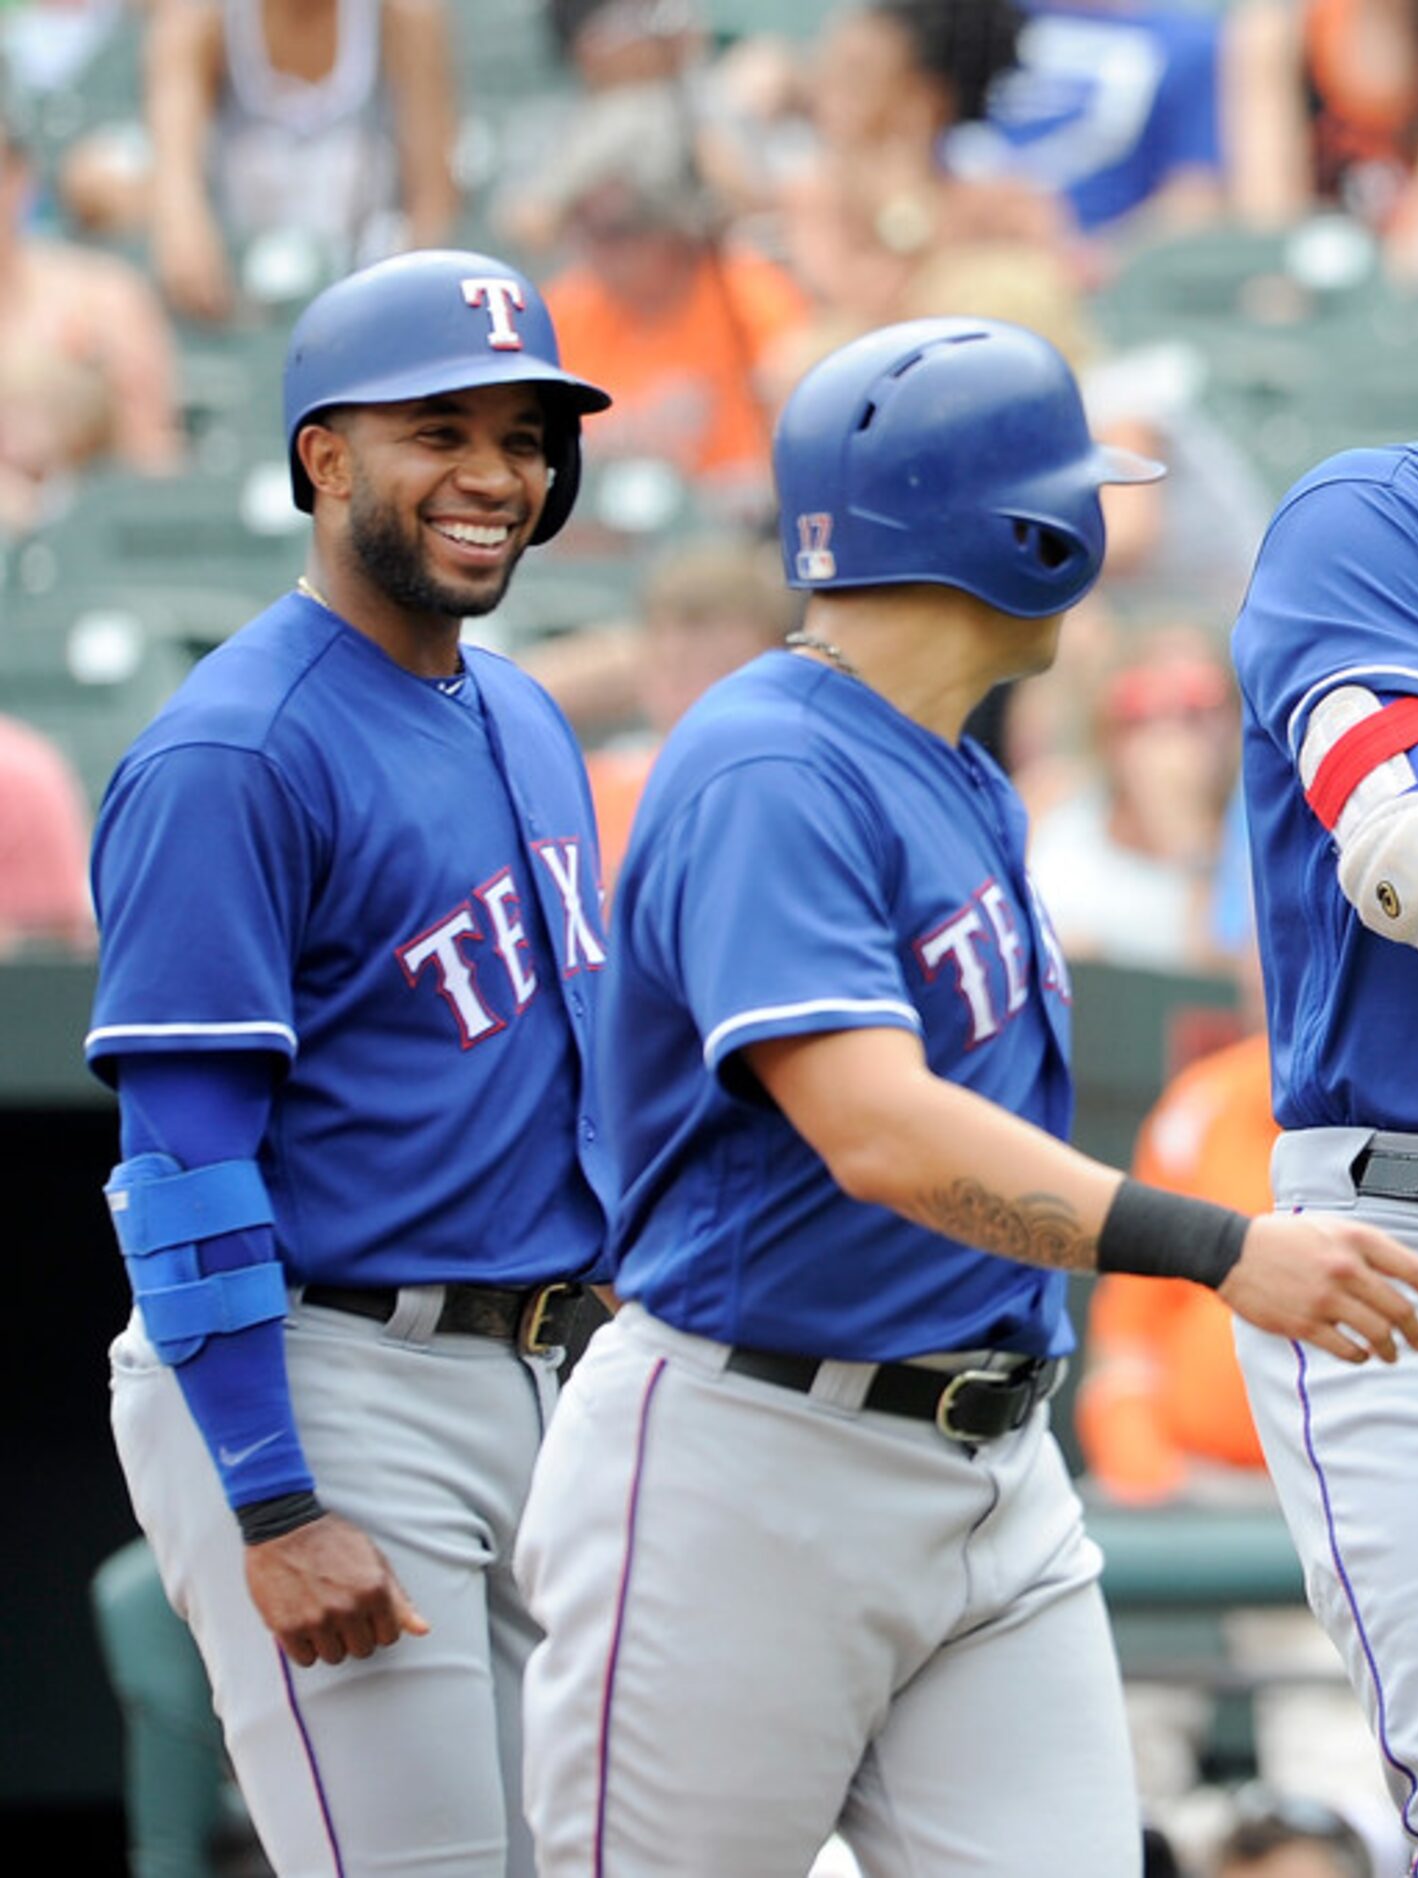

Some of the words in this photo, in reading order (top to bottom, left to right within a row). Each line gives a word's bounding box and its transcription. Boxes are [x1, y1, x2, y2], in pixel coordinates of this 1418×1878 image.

[461, 279, 525, 351] T
[797, 512, 833, 551] 17
[394, 834, 608, 1051] TEX
